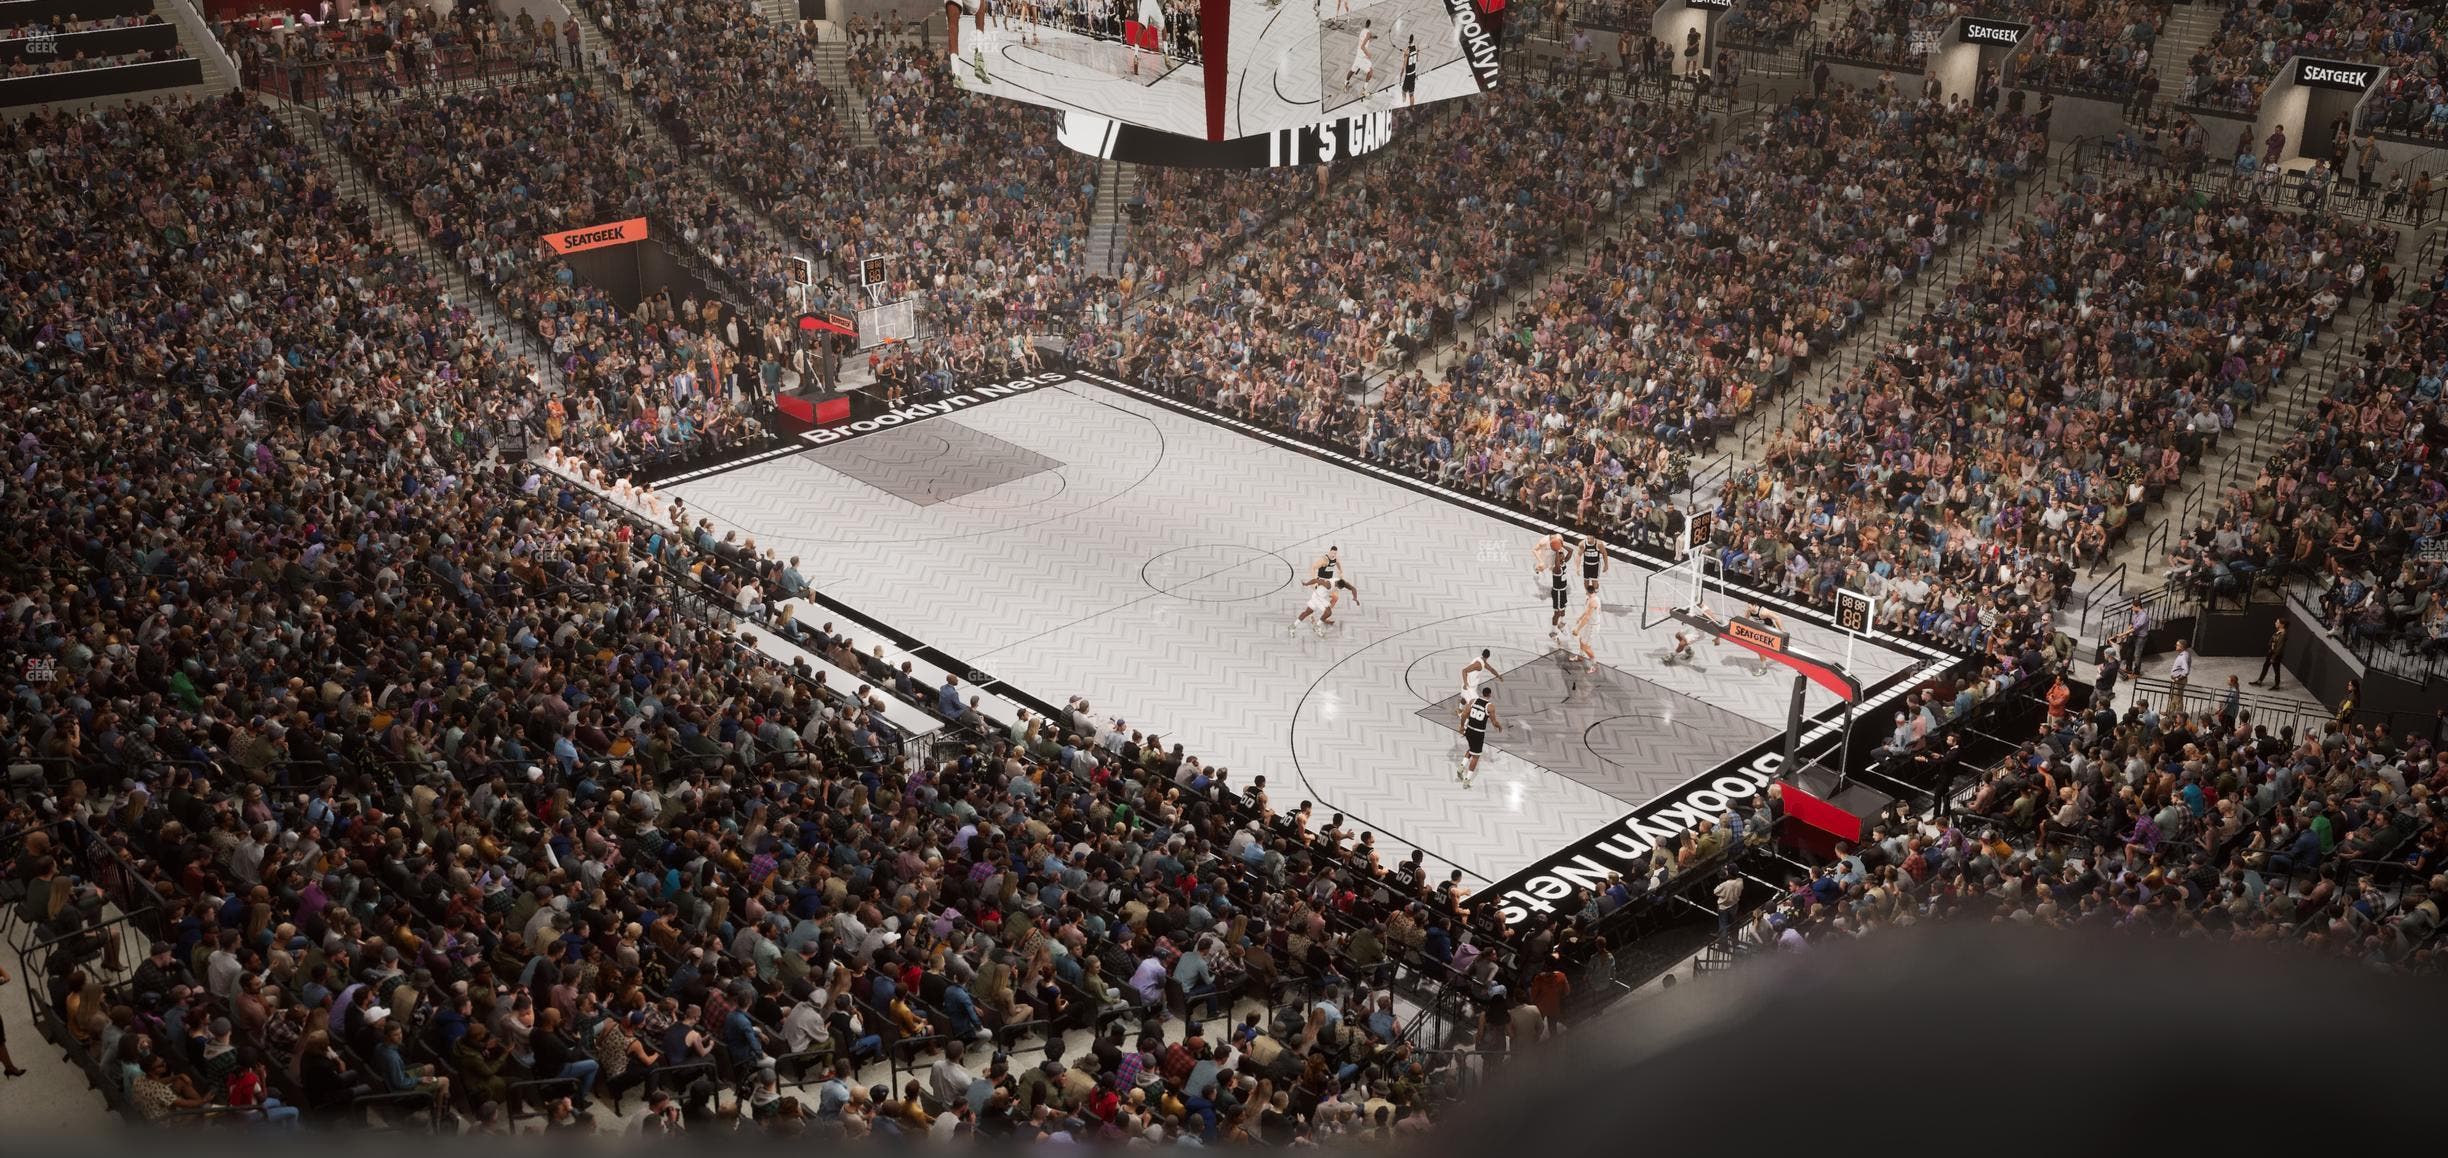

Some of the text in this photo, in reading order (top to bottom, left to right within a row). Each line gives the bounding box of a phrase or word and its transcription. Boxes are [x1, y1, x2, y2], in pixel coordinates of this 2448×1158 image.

[1967, 24, 2019, 43] SEATGEEK
[2303, 65, 2368, 88] SEATGEEK
[564, 225, 625, 249] SEATGEEK
[798, 372, 1067, 444] Brooklyn Nets
[1842, 595, 1866, 613] 88 88
[1843, 608, 1862, 630] 88
[1735, 625, 1776, 647] SEATGEEK
[1395, 870, 1413, 885] 00
[1487, 854, 1623, 924] Nets
